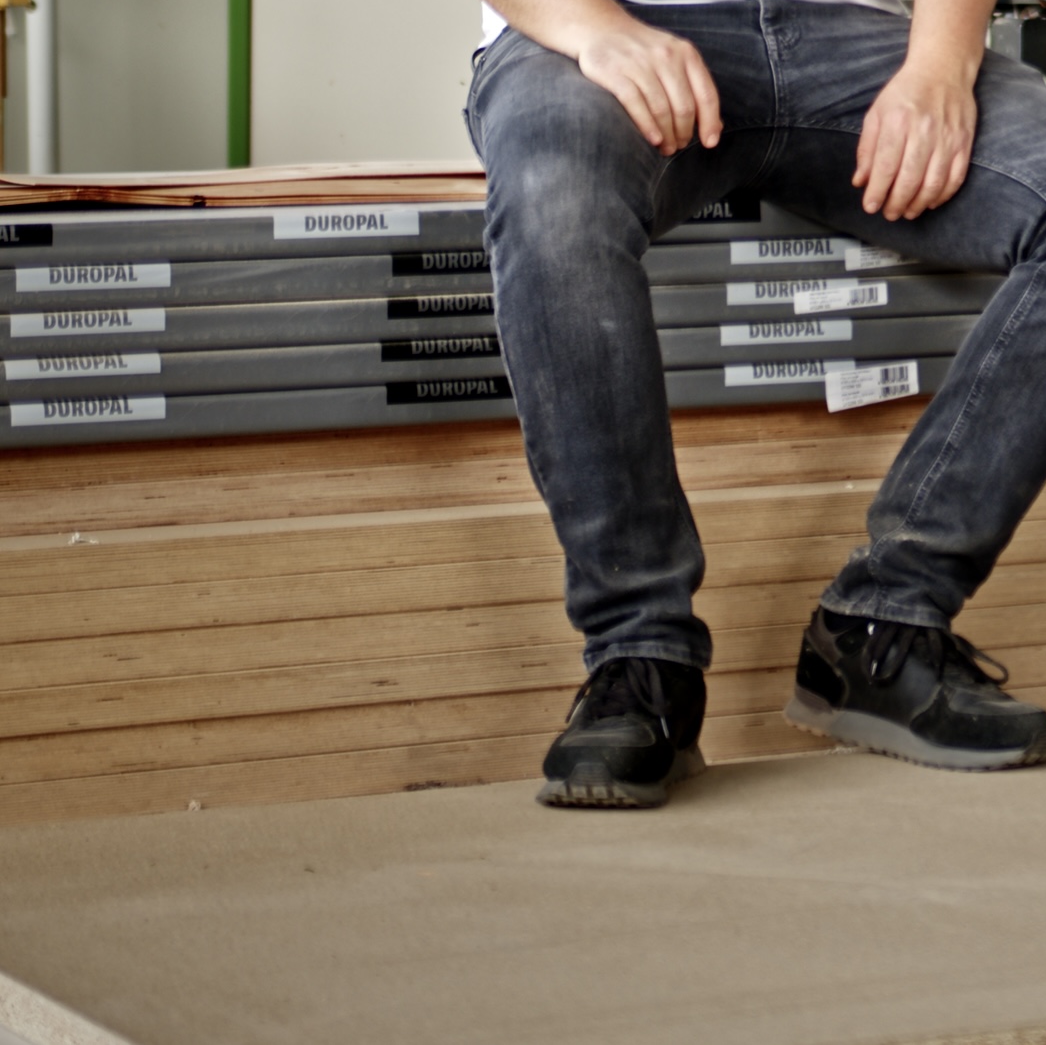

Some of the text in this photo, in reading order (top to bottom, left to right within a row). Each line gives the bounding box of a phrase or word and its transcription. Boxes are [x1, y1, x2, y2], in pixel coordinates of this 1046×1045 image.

[304, 214, 388, 233] DUROPAL
[758, 239, 833, 258] DUROPAL
[422, 251, 491, 270] DUROPA
[49, 262, 138, 285] DUROPAL
[43, 308, 132, 330] DUROPAL
[750, 320, 824, 338] DUROPAL
[411, 337, 493, 355] DUROPAL
[38, 352, 128, 372] DUROPAL
[753, 360, 828, 379] DUROPAL
[416, 380, 499, 397] DUROPAL
[43, 396, 133, 418] DUROPAL
